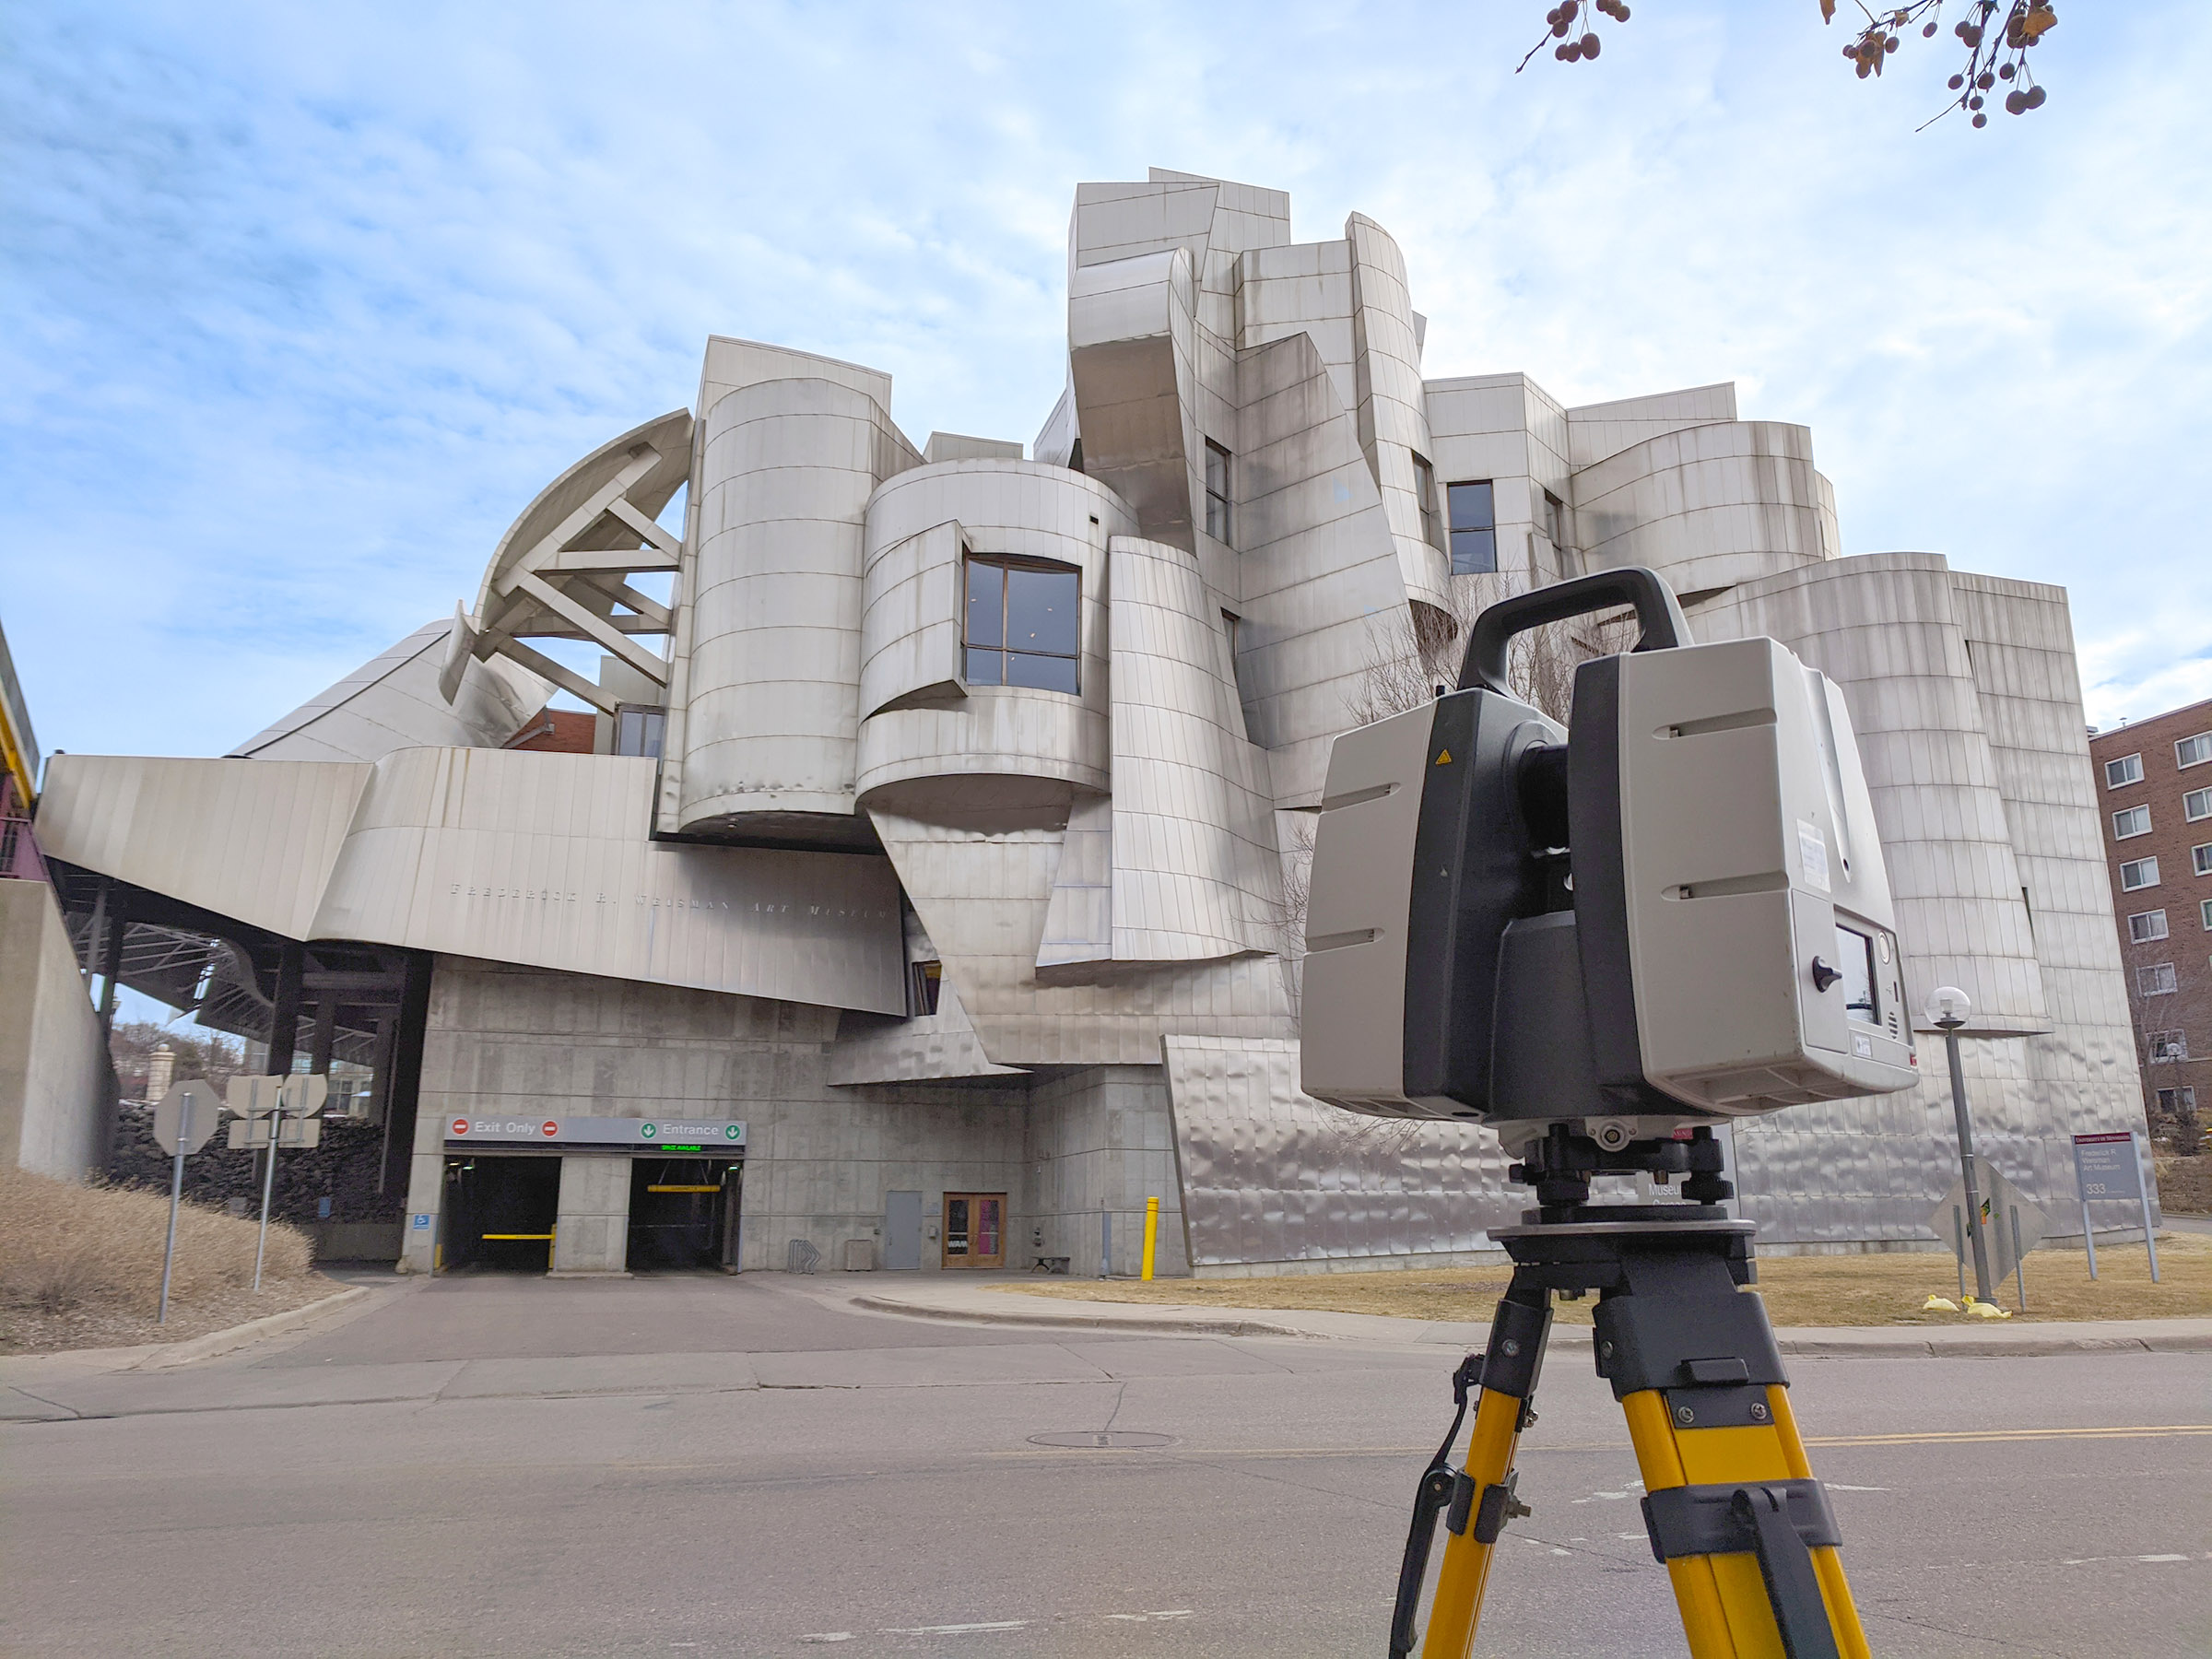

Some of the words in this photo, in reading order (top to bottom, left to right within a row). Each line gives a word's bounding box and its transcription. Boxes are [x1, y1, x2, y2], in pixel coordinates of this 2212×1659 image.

[634, 894, 731, 911] WEISMAN
[752, 902, 789, 913] ART
[475, 1122, 500, 1133] Exit
[506, 1122, 535, 1135] Only
[664, 1124, 719, 1136] Entrance
[1648, 1183, 1681, 1196] Museu
[2086, 1183, 2106, 1194] 333
